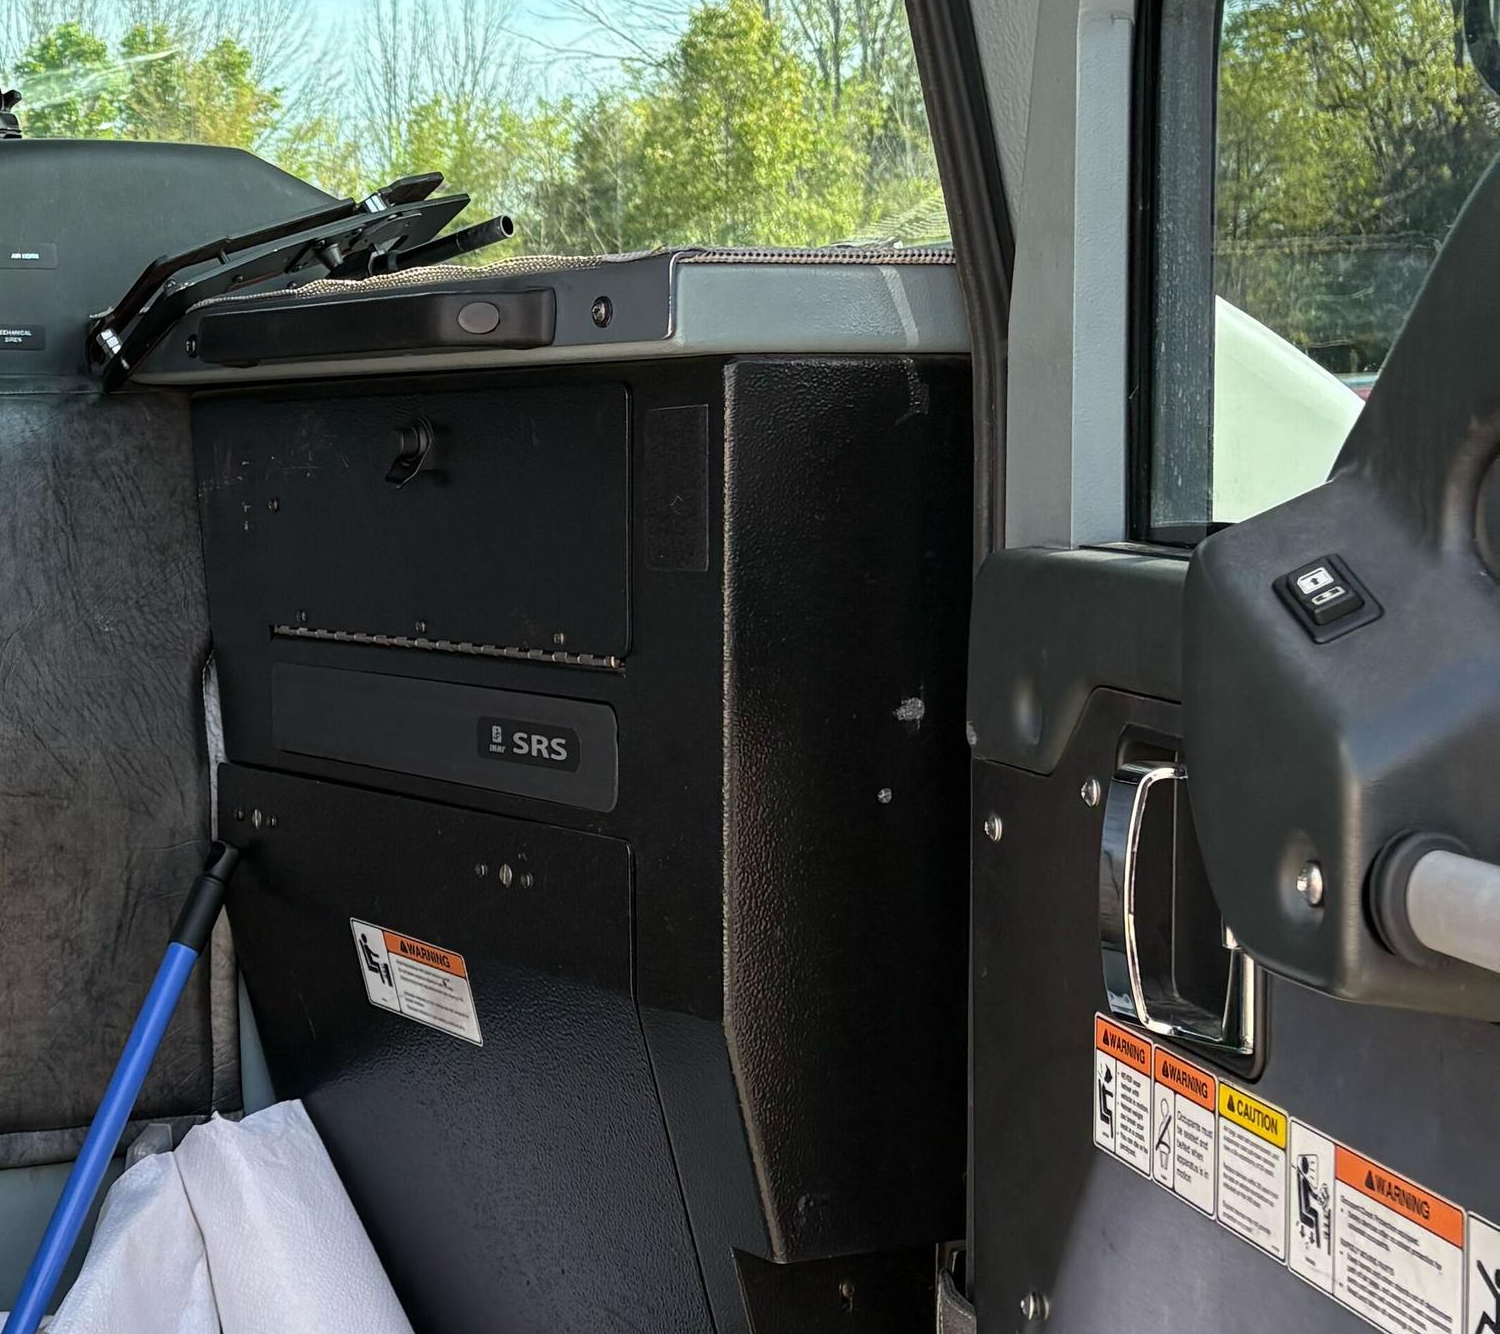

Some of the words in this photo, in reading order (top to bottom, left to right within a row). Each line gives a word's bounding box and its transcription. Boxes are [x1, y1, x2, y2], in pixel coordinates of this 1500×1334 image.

[513, 732, 567, 761] SRS
[407, 943, 450, 968] WARNING
[1109, 1031, 1145, 1065] WARNING
[1169, 1064, 1208, 1099] WARNING
[1237, 1100, 1278, 1135] CAUTION
[1375, 1175, 1430, 1220] WARNING
